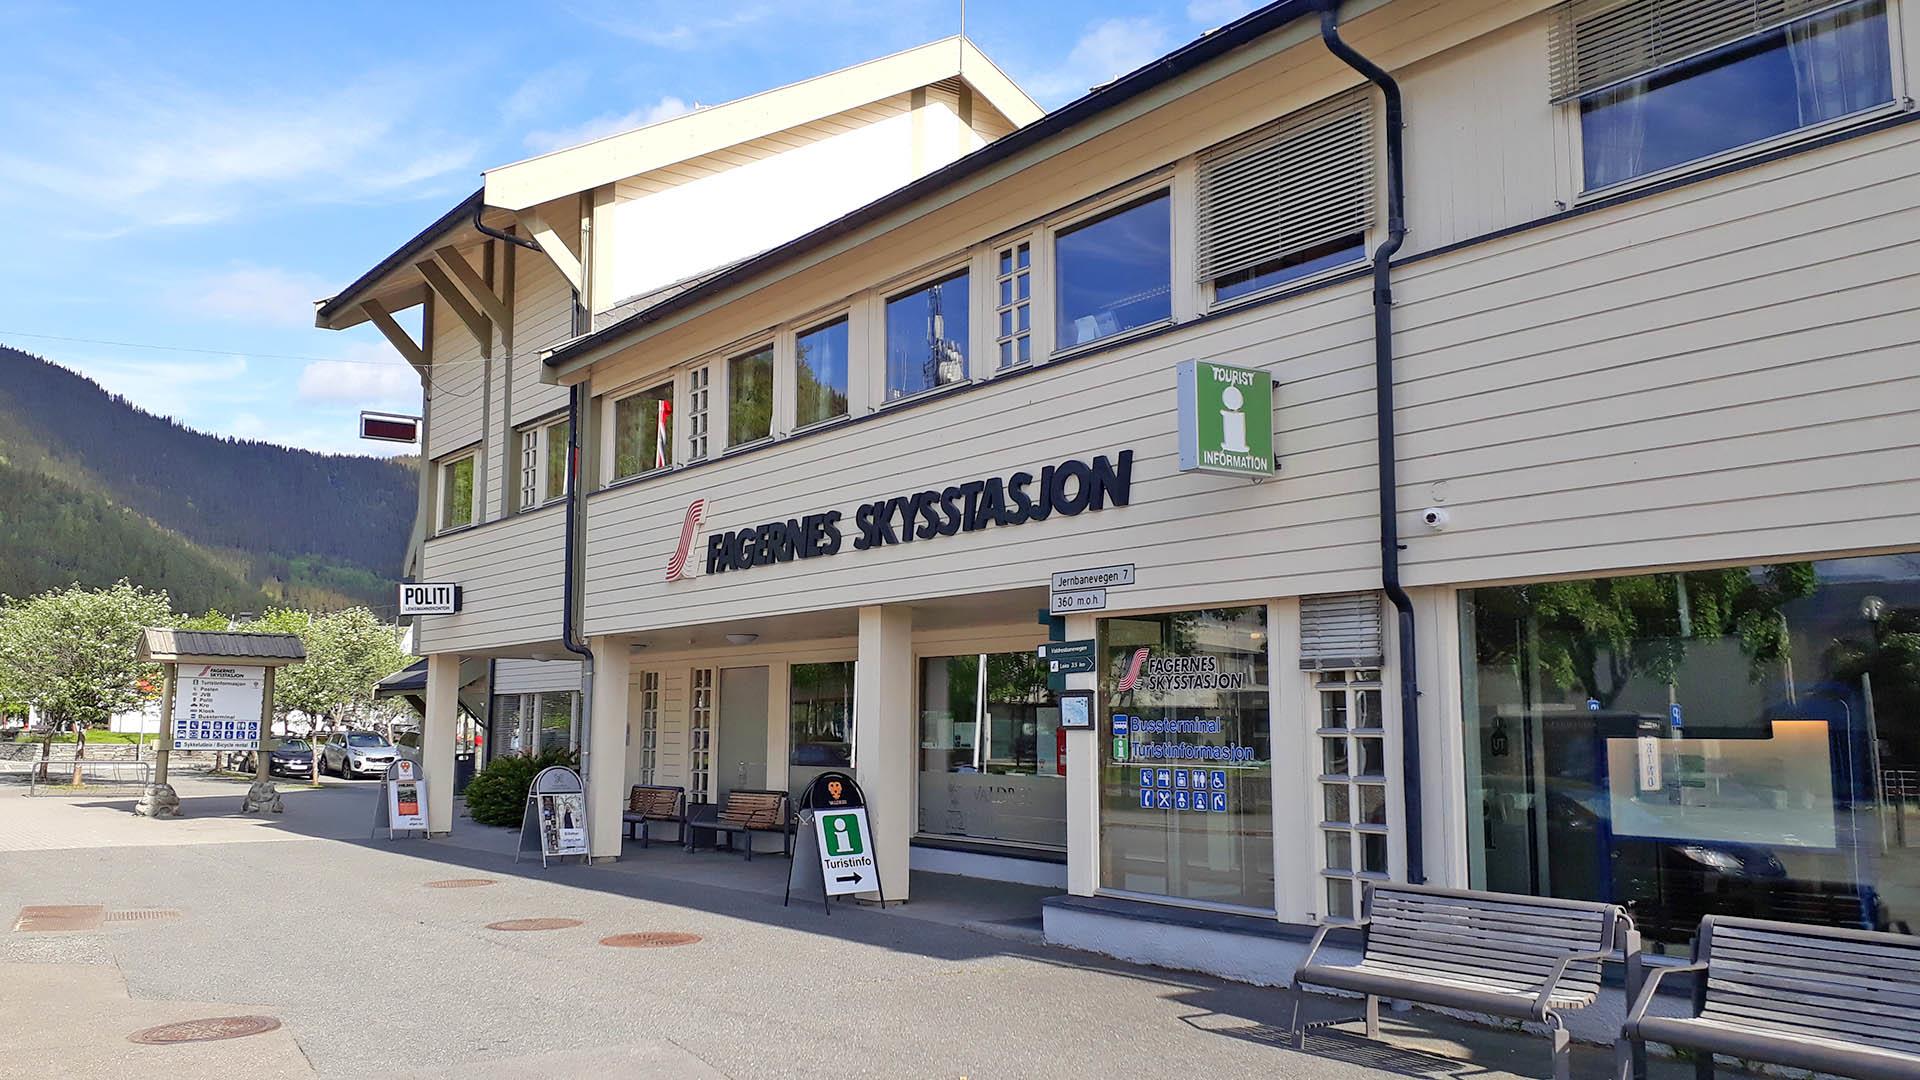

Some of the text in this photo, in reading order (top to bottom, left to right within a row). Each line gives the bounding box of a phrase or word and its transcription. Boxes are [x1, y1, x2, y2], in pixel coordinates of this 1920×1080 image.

[1210, 365, 1255, 386] TOURIST
[1203, 451, 1267, 470] INFORMATION
[706, 450, 1134, 574] FAGERNES SKYSSTASJON
[1058, 569, 1128, 587] Jernbanevegen 7
[405, 587, 450, 605] POLITI
[1057, 596, 1073, 607] 360
[1149, 656, 1216, 673] FAGERNES
[1149, 673, 1243, 690] SKYSSTASJON
[1131, 716, 1221, 733] Bussterminal
[1132, 741, 1255, 762] Turistinformasjon
[824, 856, 872, 869] Turistinfo
